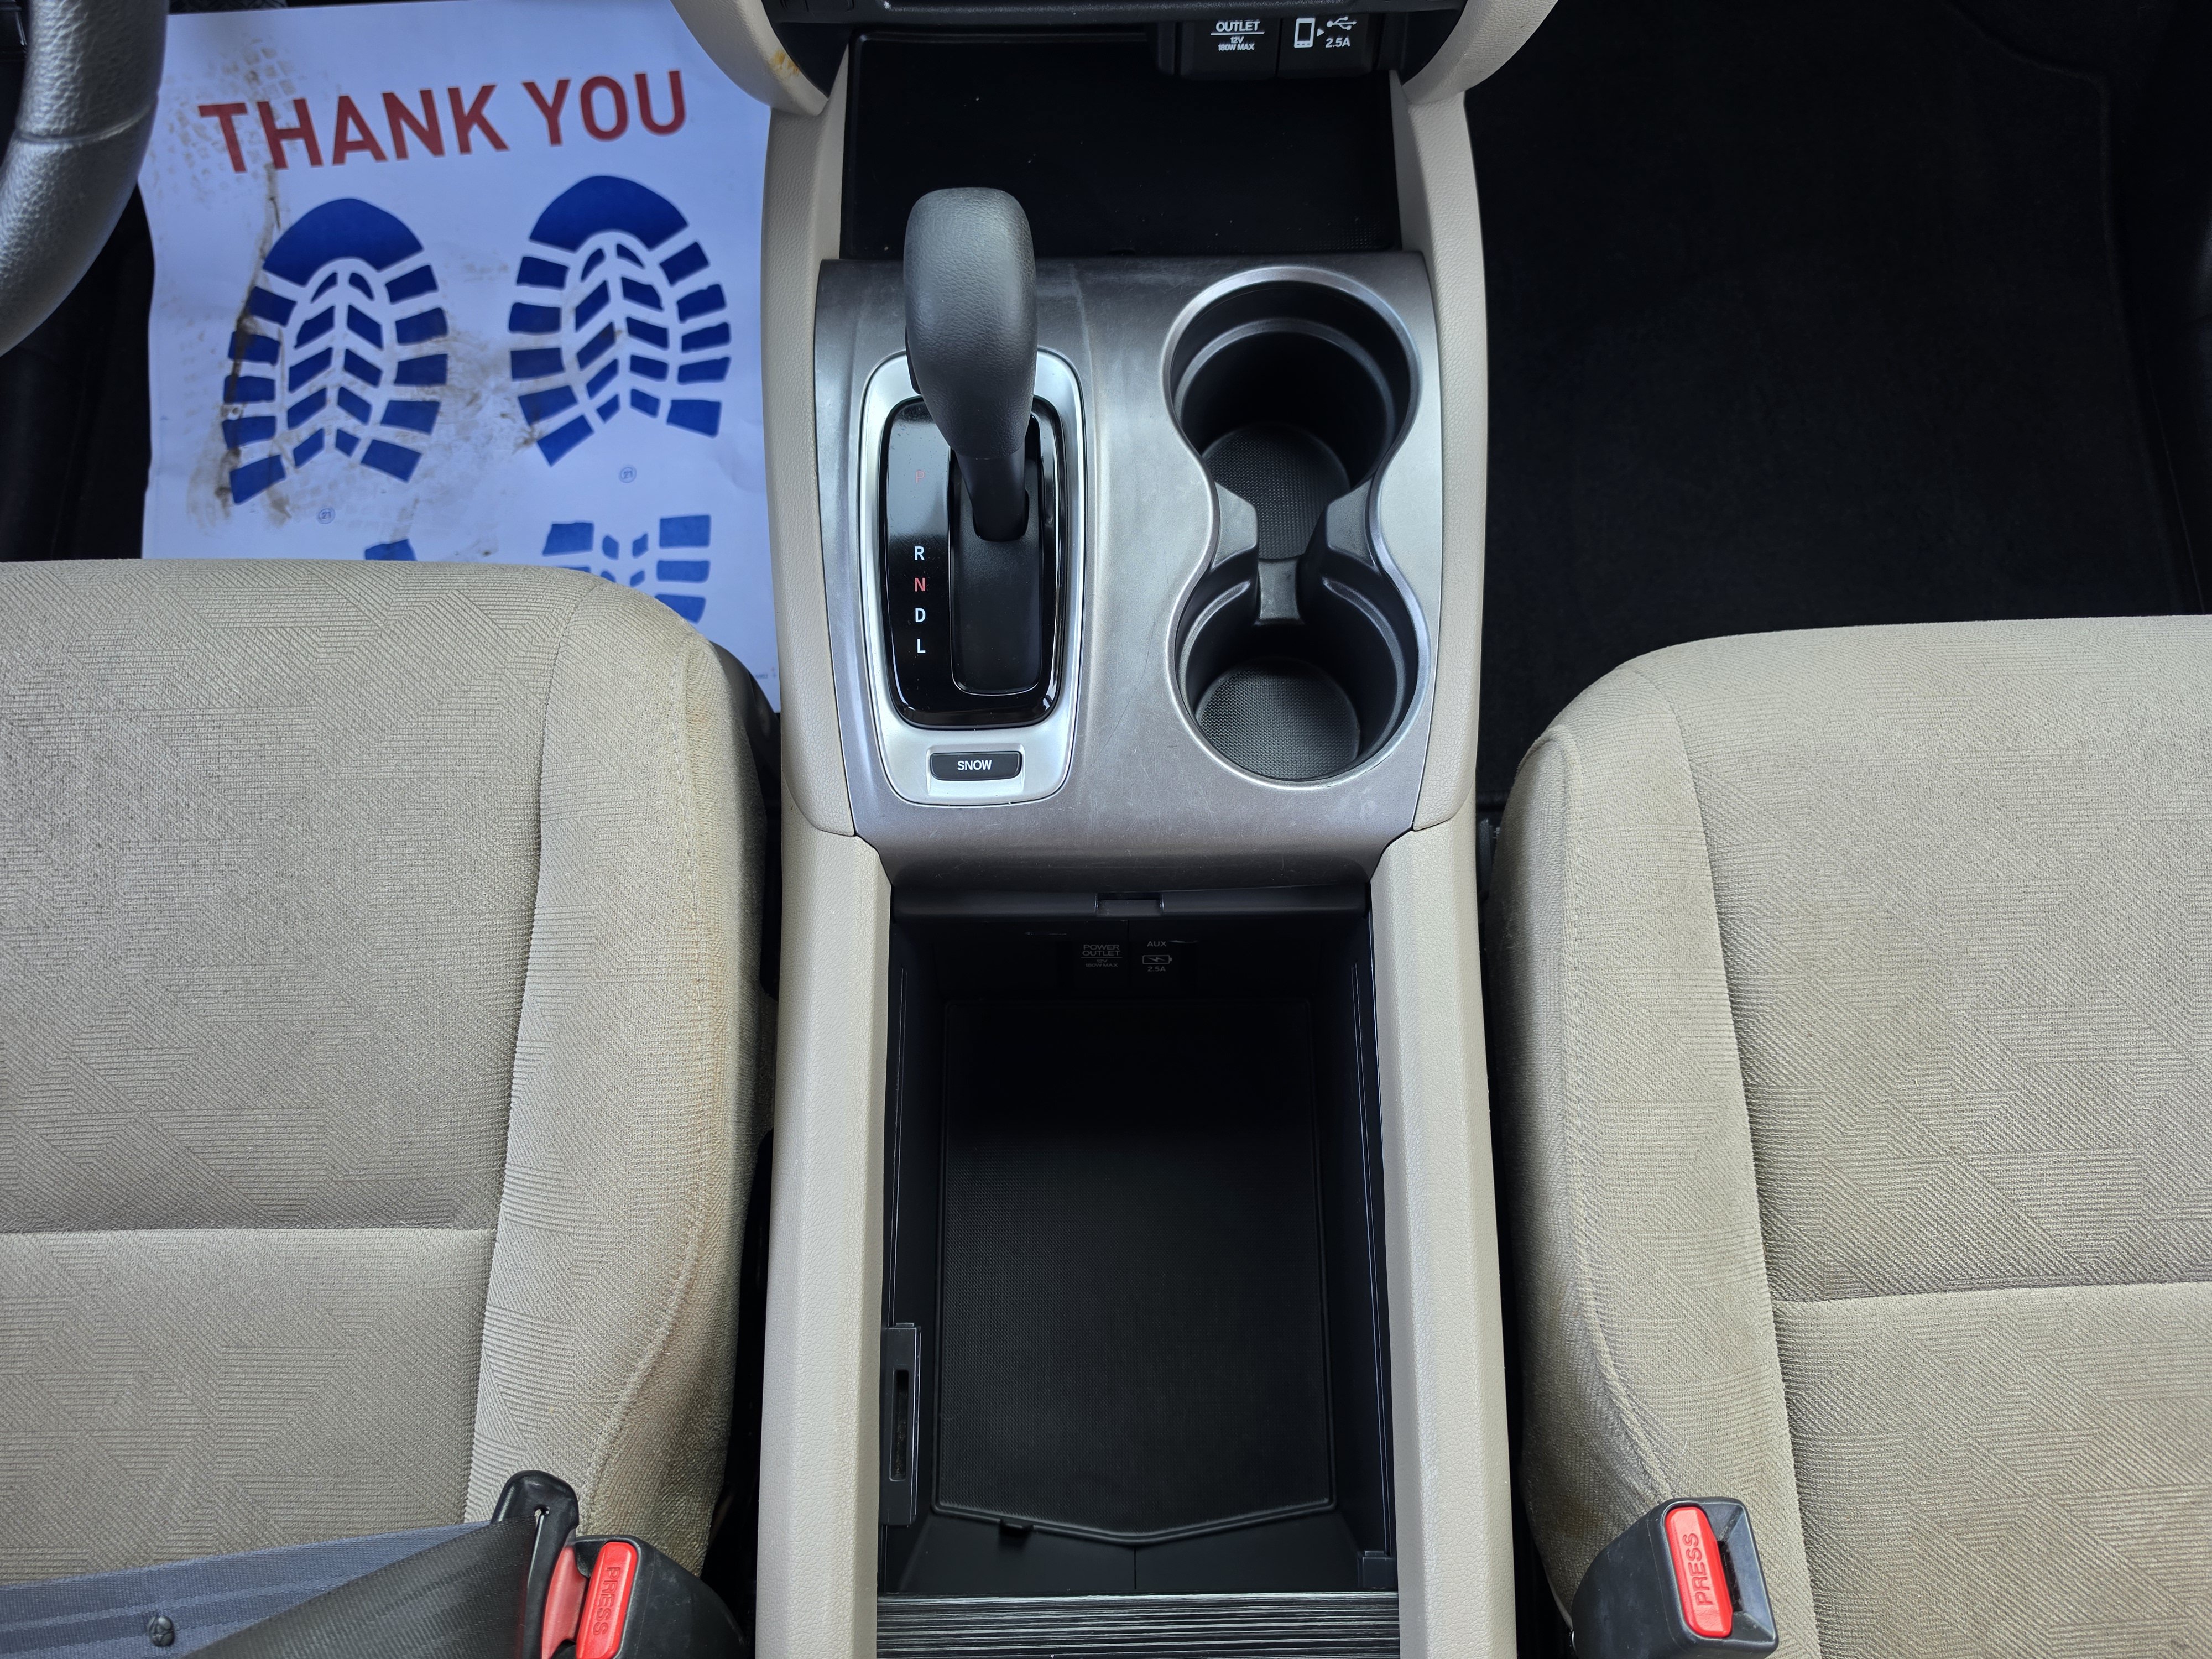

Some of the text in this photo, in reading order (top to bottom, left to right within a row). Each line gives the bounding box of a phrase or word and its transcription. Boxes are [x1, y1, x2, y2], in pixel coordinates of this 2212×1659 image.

[1216, 20, 1260, 32] OUTLET
[1326, 38, 1350, 48] 2.5A
[199, 70, 687, 174] THANK YOU
[916, 471, 925, 483] P
[914, 546, 925, 560] R
[914, 578, 926, 592] N
[915, 608, 926, 622] D
[917, 639, 926, 653] L
[957, 760, 992, 771] SNOW
[1682, 1533, 1713, 1606] PRESS
[593, 1567, 620, 1636] PRESS
